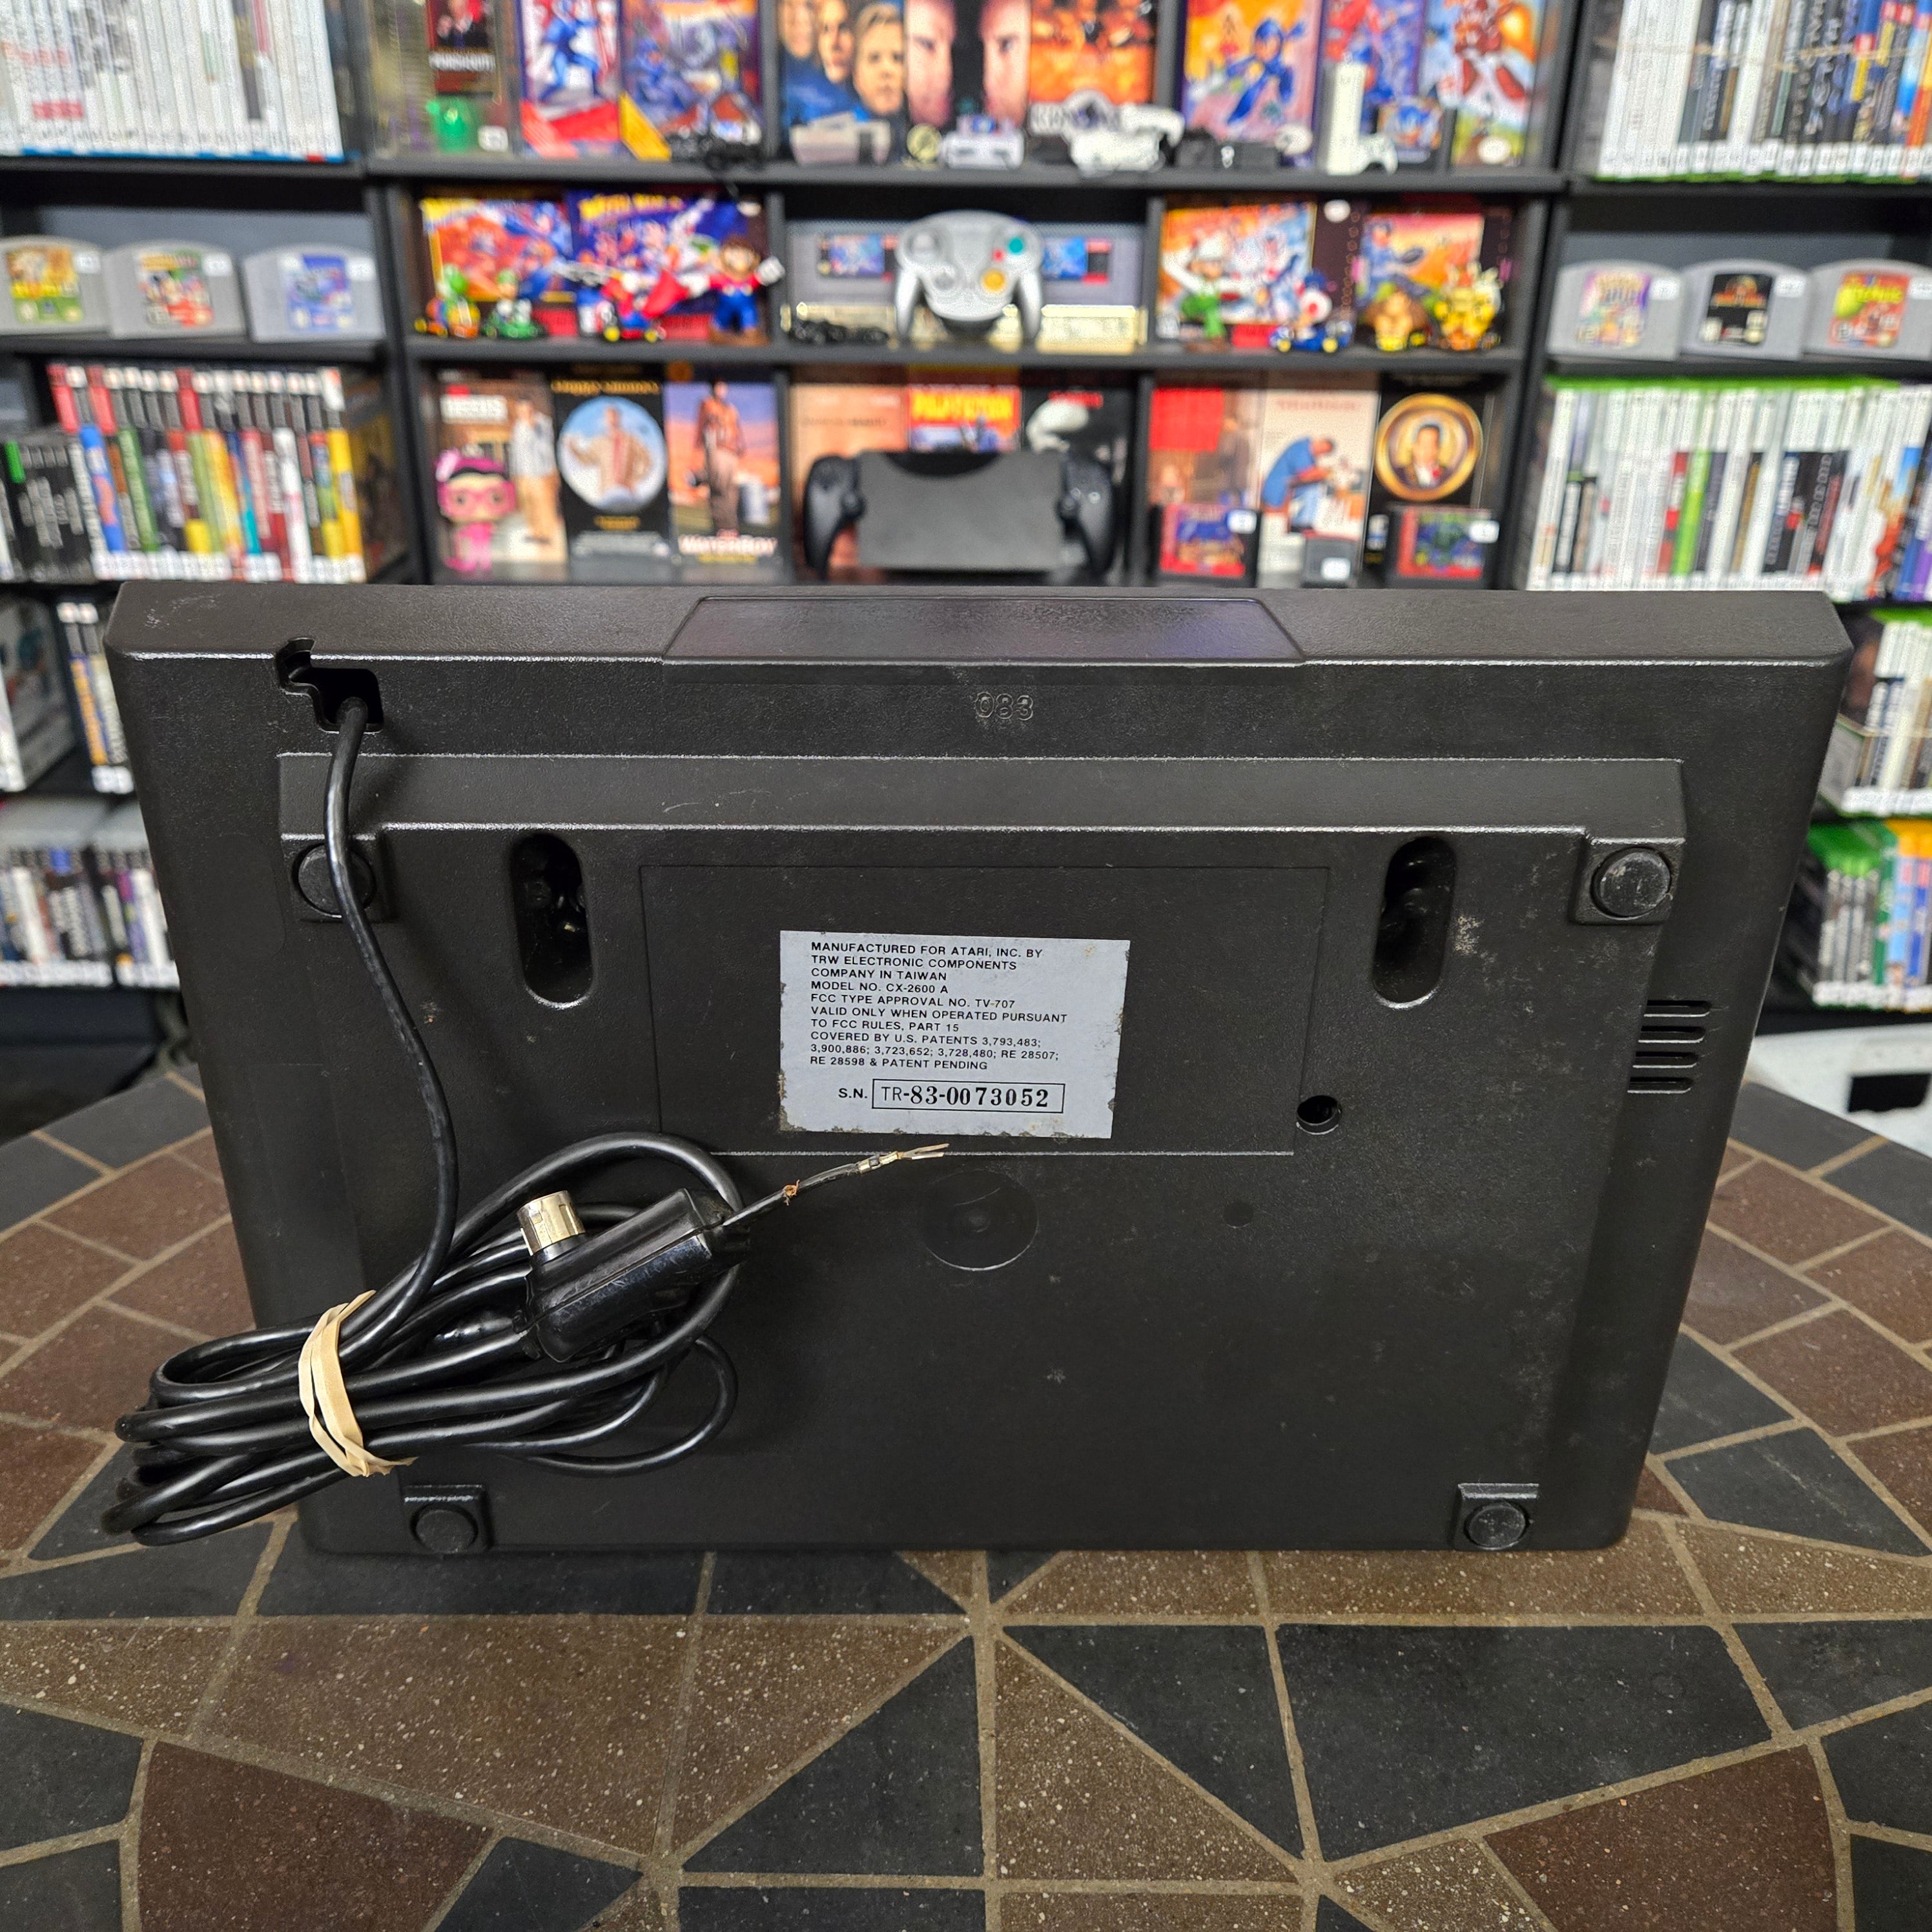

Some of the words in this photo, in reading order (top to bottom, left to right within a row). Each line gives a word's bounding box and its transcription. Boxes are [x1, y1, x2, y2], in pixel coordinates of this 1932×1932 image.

[974, 692, 1034, 721] 083
[811, 941, 916, 954] MANUFACTURED
[920, 945, 946, 955] FOR
[951, 946, 992, 958] ATARI,
[996, 948, 1021, 958] INC.
[1026, 949, 1043, 958] BY
[811, 954, 839, 965] TRW
[844, 956, 923, 967] ELECTRONIC
[928, 958, 1017, 971] COMPONENTS
[811, 967, 875, 978] COMPANY
[879, 970, 892, 980] IN
[896, 971, 947, 981] TAIWAN
[811, 980, 854, 991] MODEL
[859, 982, 881, 992] NO.
[886, 983, 936, 993] CX-2600
[940, 985, 949, 994] A
[811, 993, 836, 1003] FCC
[841, 994, 872, 1004] TYPE
[877, 996, 943, 1007] APPROVAL
[949, 998, 970, 1007] NO.
[974, 998, 1015, 1009] TV-707
[810, 1006, 847, 1016] VALID
[852, 1007, 886, 1017] ONLY
[890, 1009, 927, 1018] WHEN
[932, 1010, 998, 1020] OPERATED
[1002, 1012, 1067, 1023] PURSUANT
[810, 1018, 827, 1028] TO
[832, 1019, 858, 1029] FCC
[862, 1020, 904, 1031] RULES,
[909, 1022, 941, 1031] PART
[946, 1023, 959, 1032] 15
[810, 1031, 869, 1042] COVERED
[874, 1033, 890, 1042] BY
[894, 1034, 917, 1043] U.S.
[921, 1035, 978, 1045] PATENTS
[982, 1037, 1041, 1048] 3,793,483;
[810, 1043, 870, 1055] 3,900,886;
[874, 1045, 933, 1057] 3,723,652;
[938, 1047, 996, 1059] 3,728,480;
[1001, 1049, 1016, 1059] RE
[1021, 1051, 1058, 1061] 28507;
[810, 1056, 826, 1065] RE
[830, 1056, 865, 1066] 28598
[869, 1058, 878, 1067] &
[882, 1058, 930, 1068] PATENT
[934, 1060, 987, 1070] PENDING
[838, 1088, 868, 1099] S.N.
